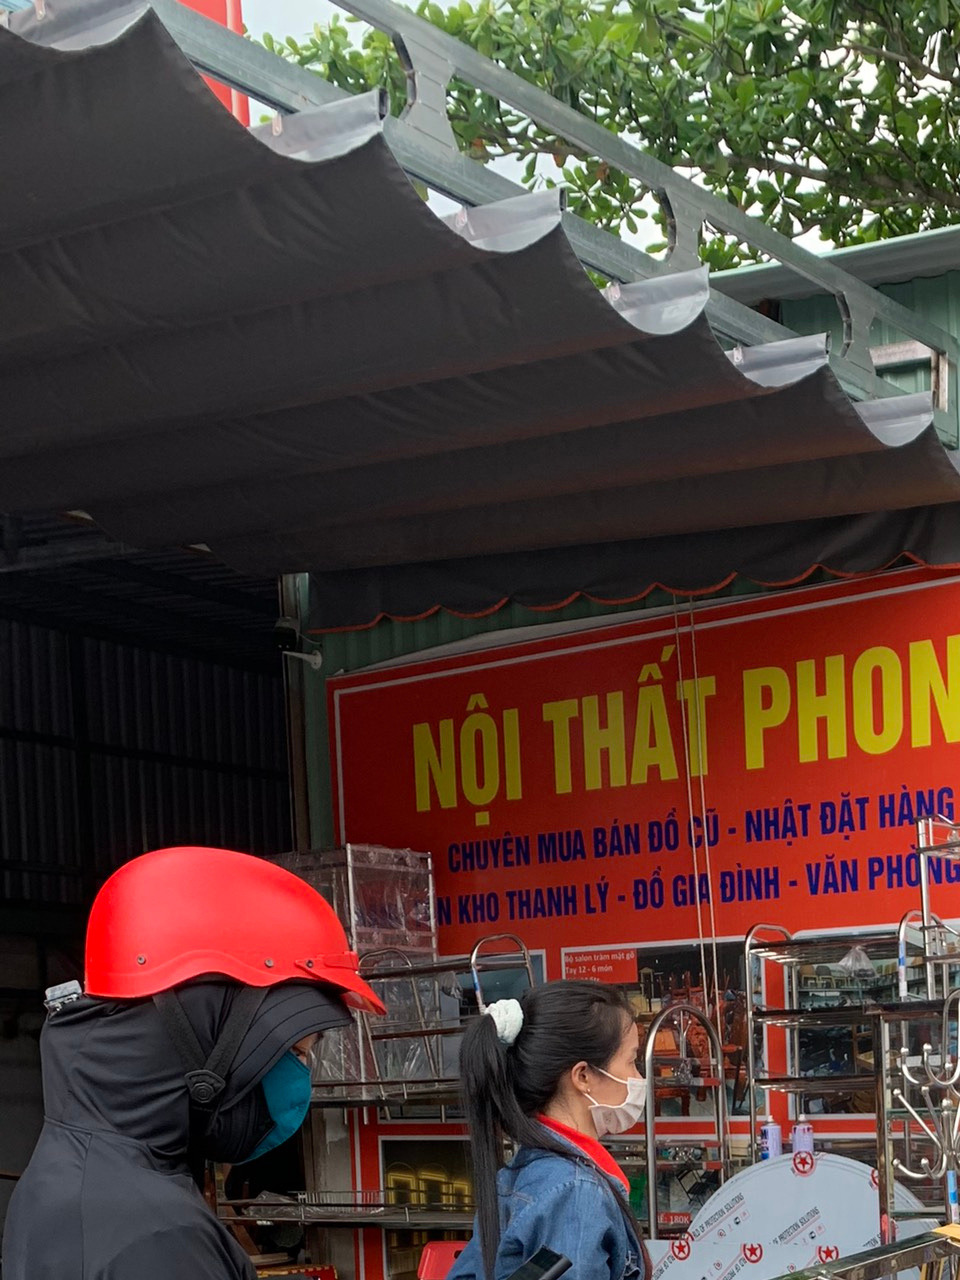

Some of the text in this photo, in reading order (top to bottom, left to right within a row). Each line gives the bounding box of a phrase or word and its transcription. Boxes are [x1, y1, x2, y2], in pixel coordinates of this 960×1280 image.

[412, 692, 522, 826] NỘI
[543, 645, 716, 794] THẤT
[449, 831, 530, 873] CHUYÊN
[538, 829, 587, 864] MUA
[593, 818, 640, 858] BÁN
[648, 808, 679, 853] ĐỒ
[688, 808, 719, 849] CŨ
[745, 798, 811, 846] NHẬT
[819, 792, 870, 841] ĐẶT
[879, 785, 954, 828] HÀNG
[458, 892, 500, 924] KHO
[506, 885, 577, 920] THANH
[585, 876, 609, 915] LÝ
[633, 866, 664, 910] ĐỒ
[672, 872, 711, 907] GIA
[720, 863, 780, 903] ĐÌNH
[806, 853, 858, 896] VĂN
